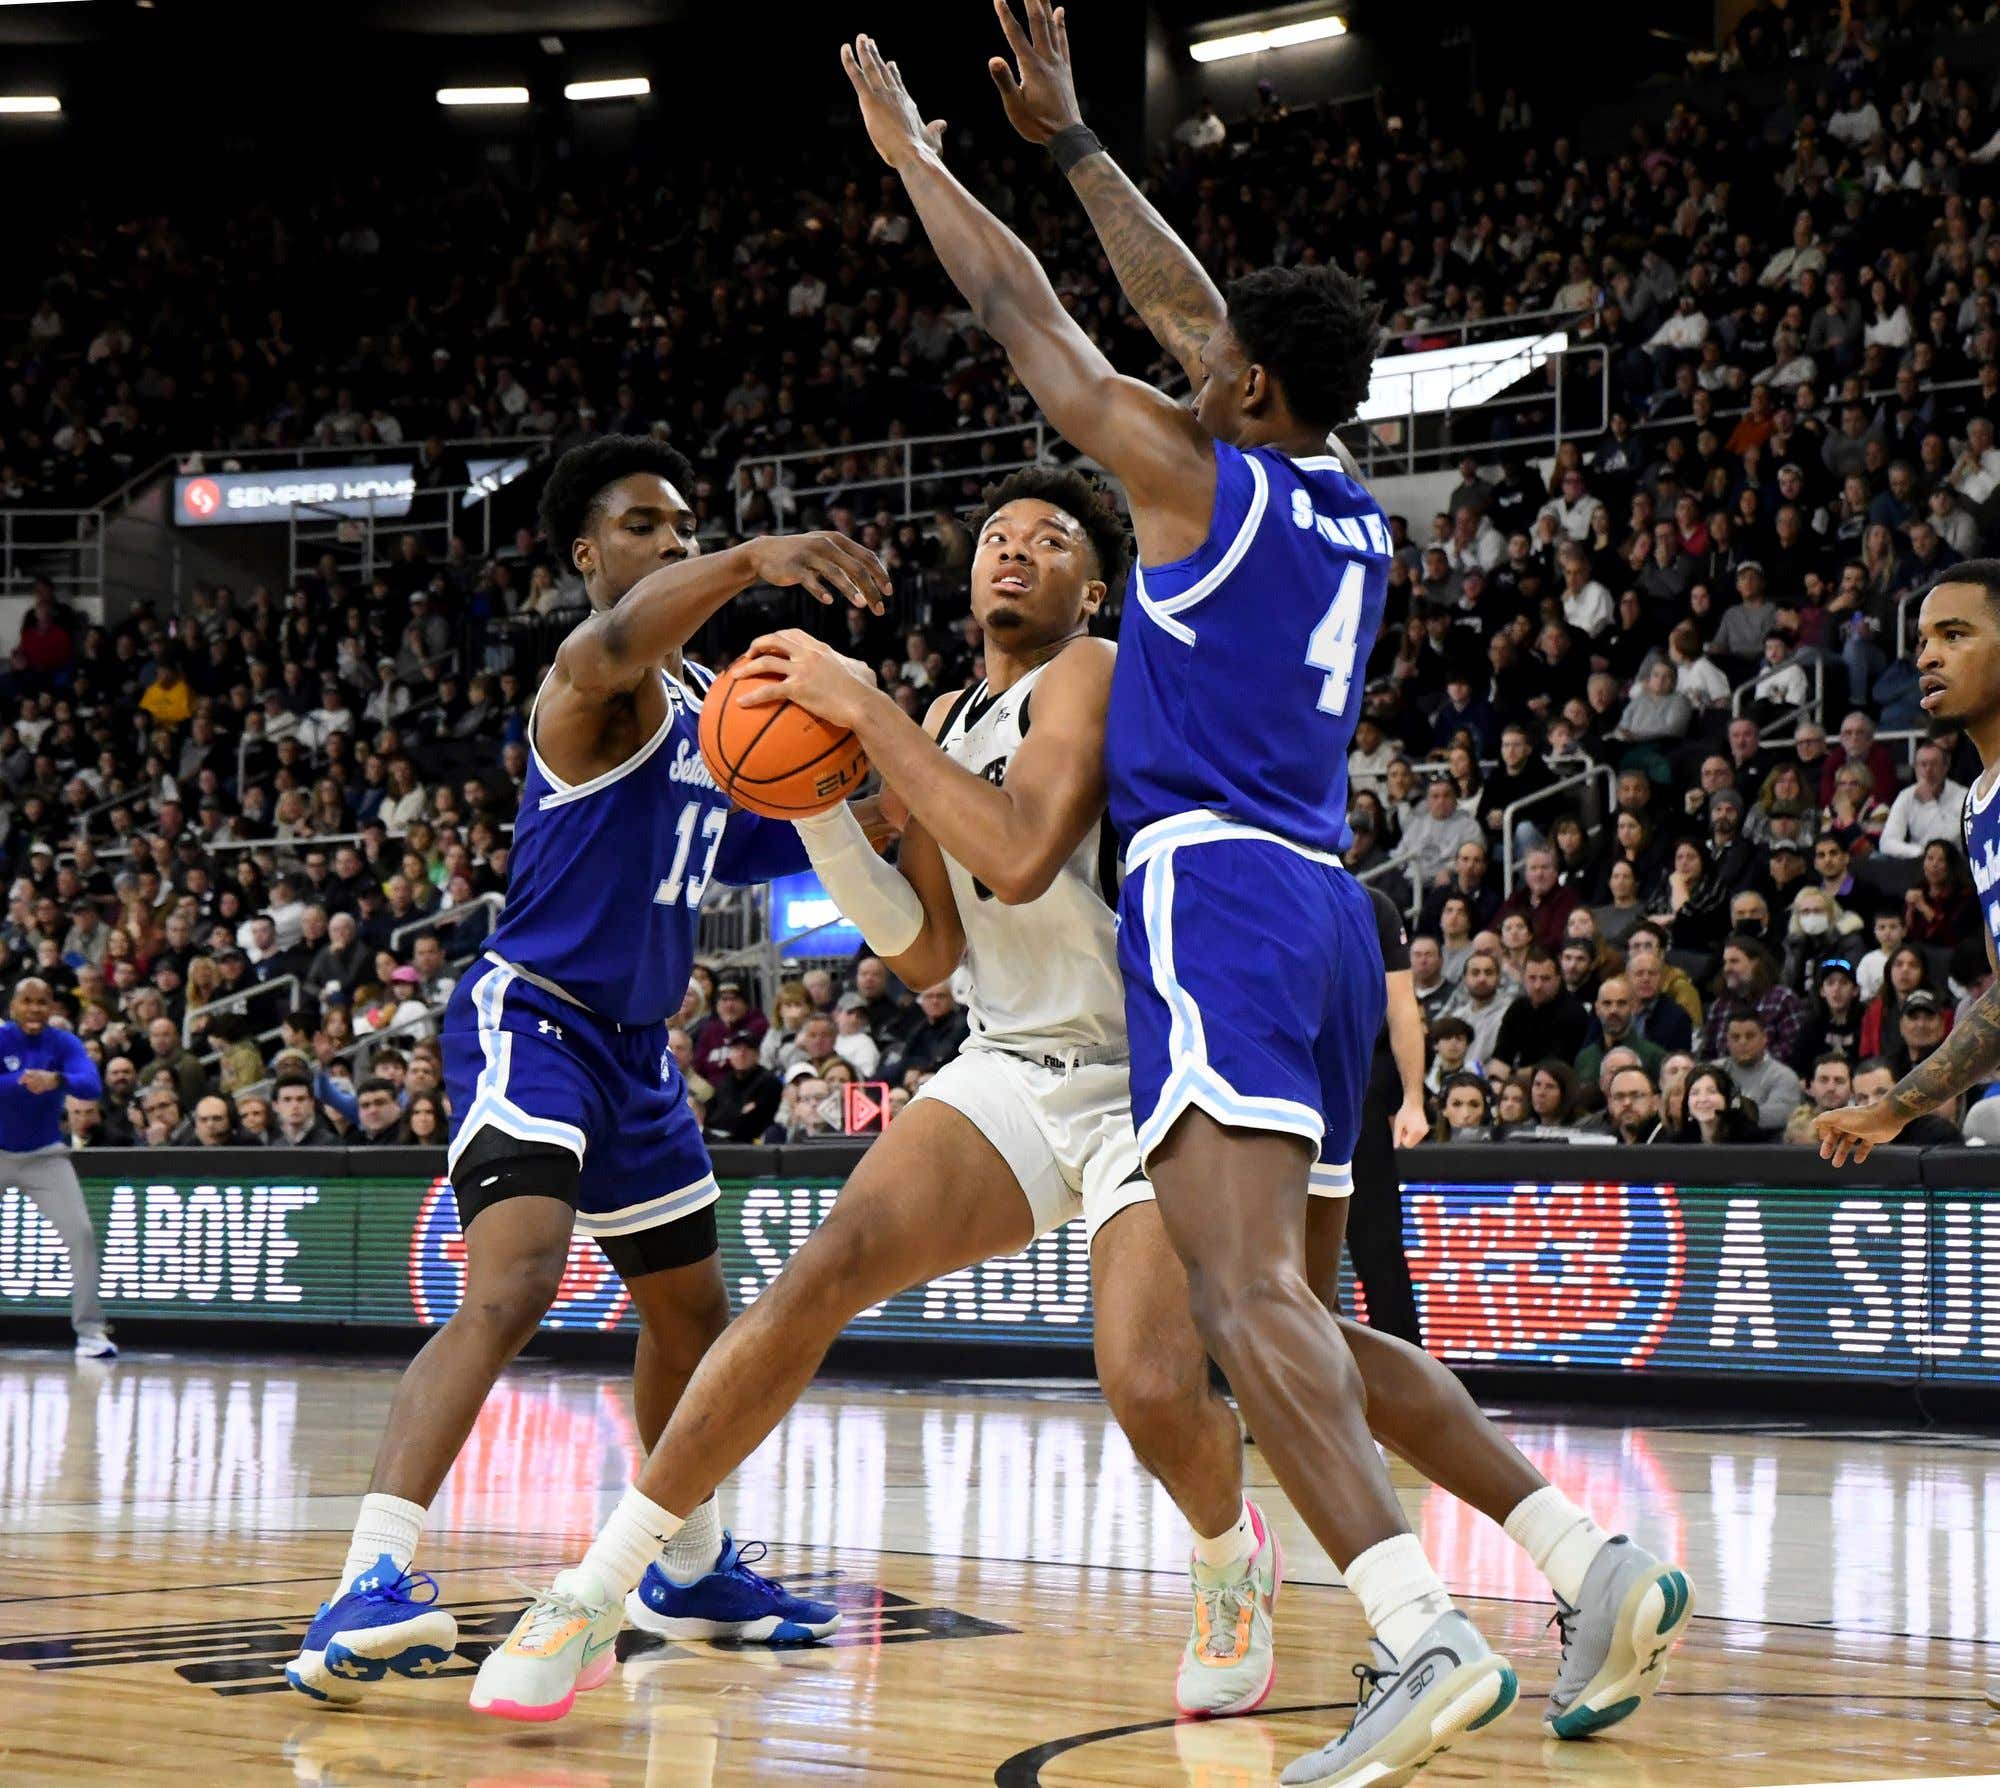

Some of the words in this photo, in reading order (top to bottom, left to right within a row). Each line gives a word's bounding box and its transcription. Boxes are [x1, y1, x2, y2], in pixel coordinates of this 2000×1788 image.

[228, 483, 338, 508] SEMPER
[1304, 560, 1367, 717] 4
[653, 801, 728, 911] 13
[98, 1185, 305, 1302] ABOVE
[1708, 1199, 1779, 1348] A
